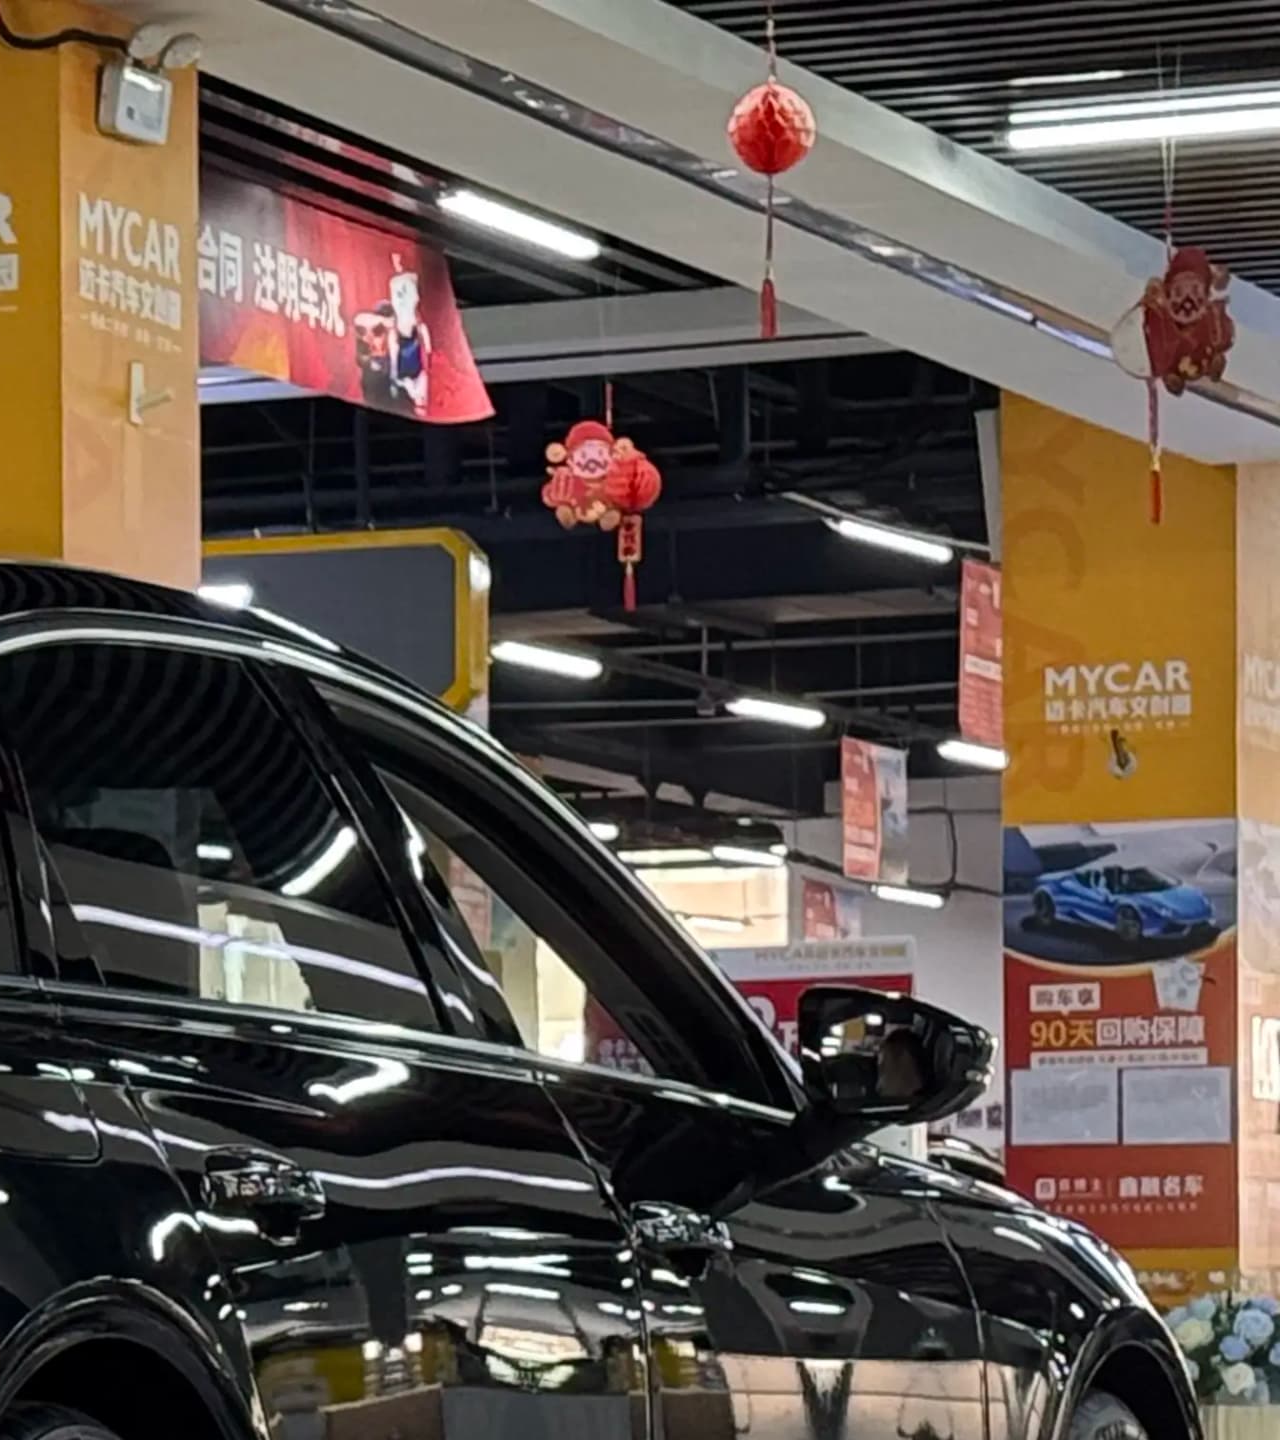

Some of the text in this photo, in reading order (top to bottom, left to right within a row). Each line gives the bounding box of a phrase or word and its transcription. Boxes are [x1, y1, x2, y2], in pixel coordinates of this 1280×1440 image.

[78, 190, 182, 284] MYCAR
[197, 224, 243, 303] 合同
[253, 241, 346, 338] 注明车况
[1044, 660, 1191, 697] MYCAR
[1030, 1015, 1206, 1048] 90天回购保障
